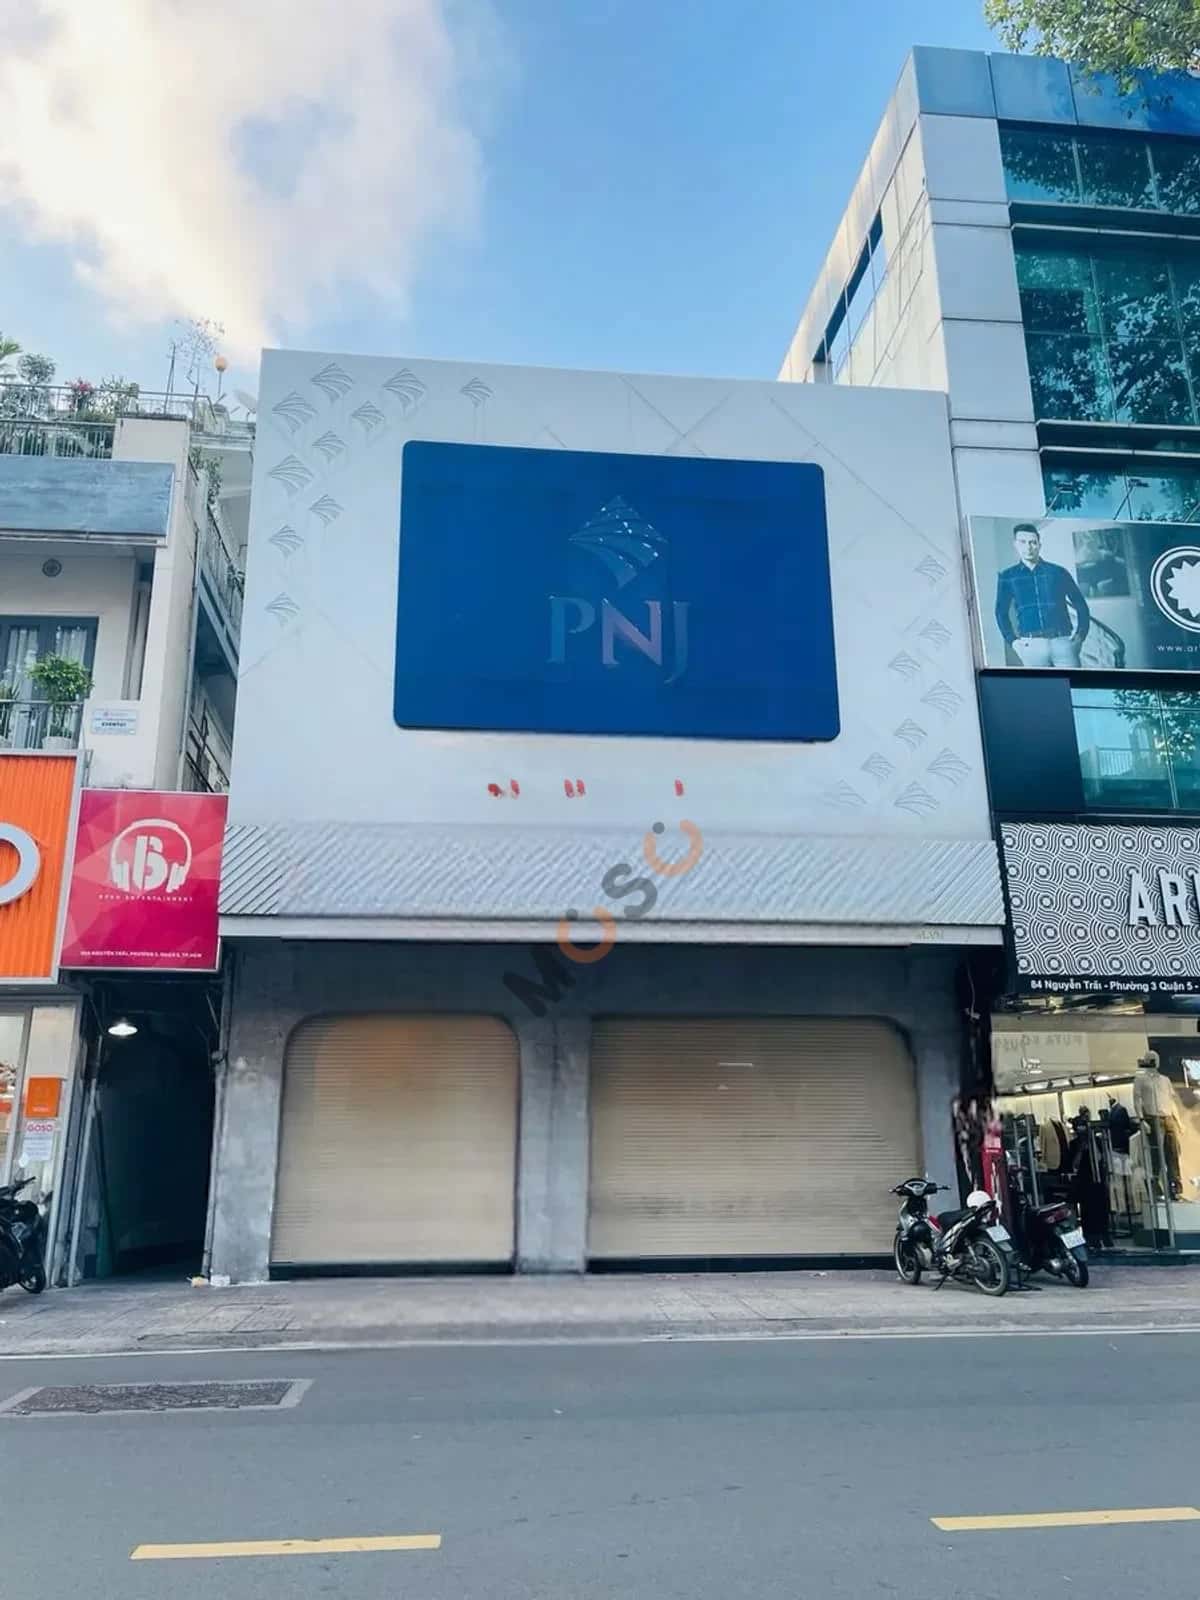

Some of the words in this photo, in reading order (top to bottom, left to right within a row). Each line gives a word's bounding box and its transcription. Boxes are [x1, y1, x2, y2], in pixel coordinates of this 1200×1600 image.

[544, 594, 692, 685] PNJ
[1156, 643, 1200, 653] www.ar
[1151, 981, 1157, 991] 3
